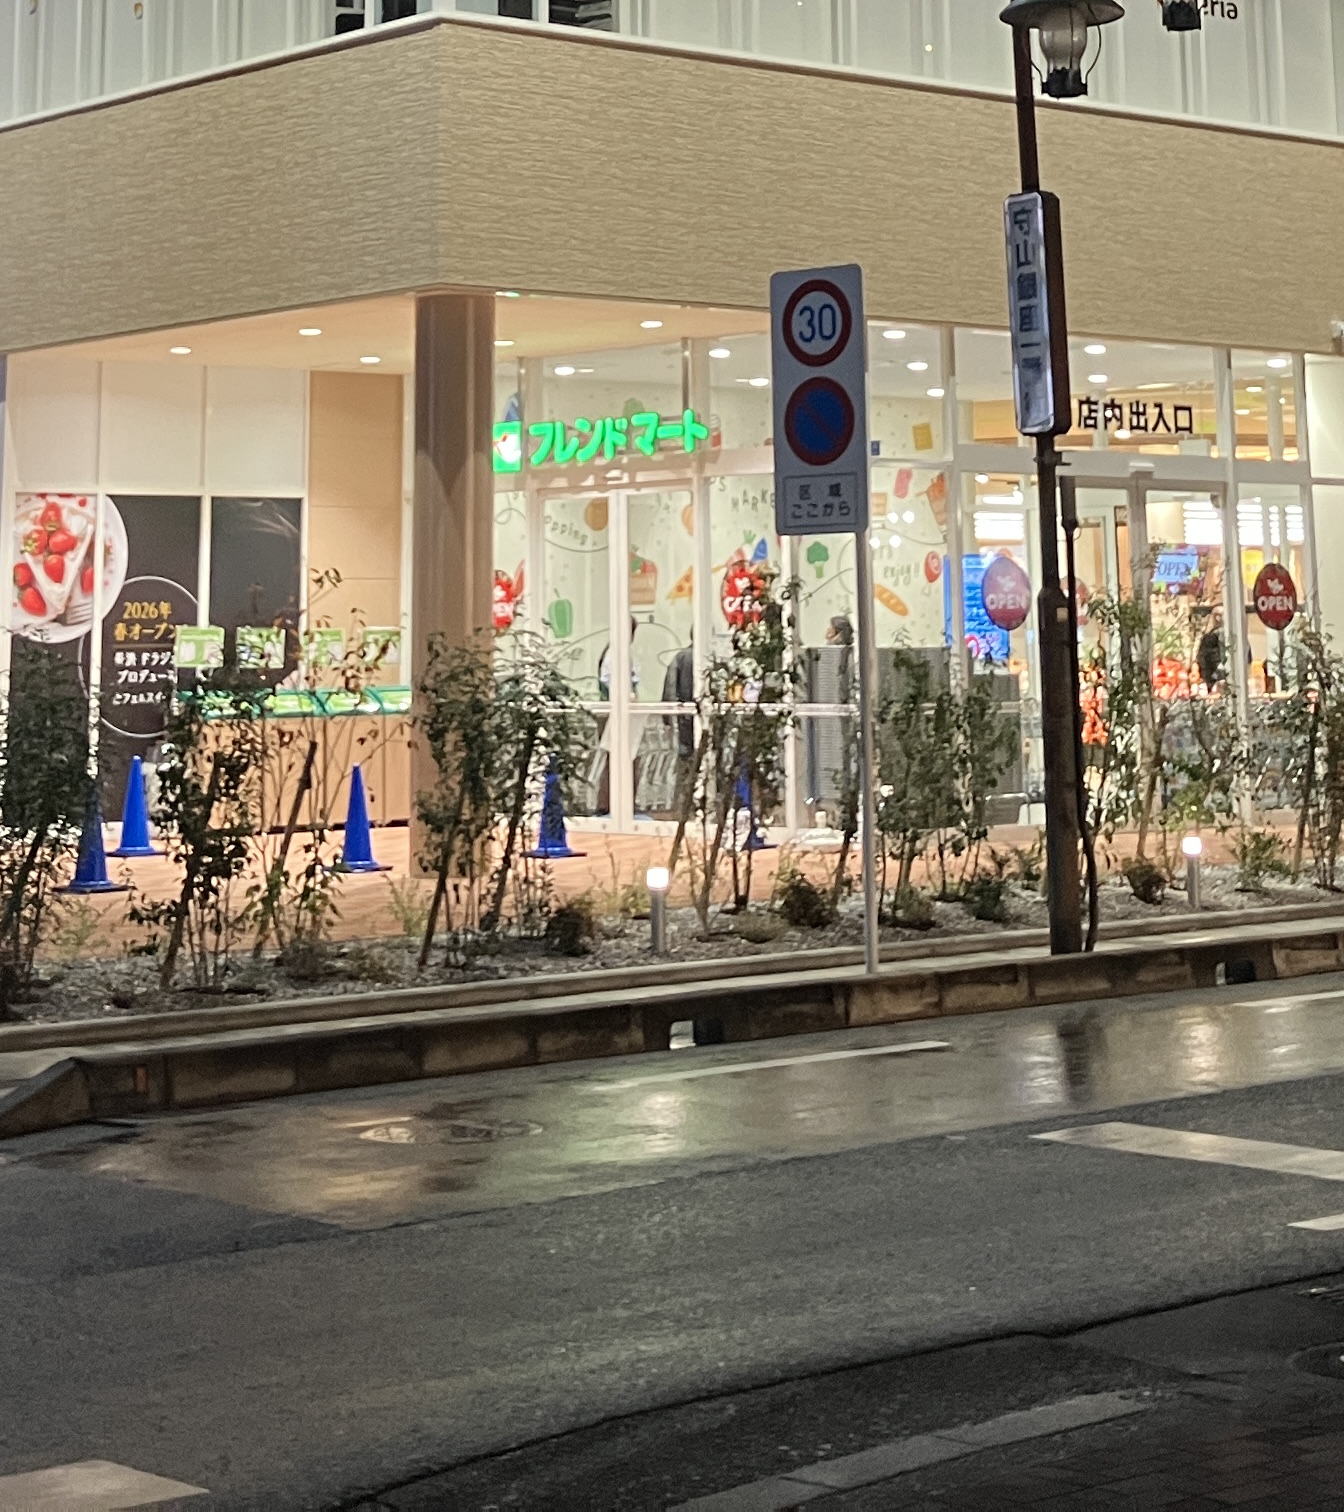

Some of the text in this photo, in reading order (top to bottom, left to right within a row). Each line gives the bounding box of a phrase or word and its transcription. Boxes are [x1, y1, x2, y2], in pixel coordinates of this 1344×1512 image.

[798, 303, 837, 344] 30
[1078, 396, 1193, 434] 店内出入口
[528, 408, 709, 466] フレンドマート
[730, 488, 775, 513] MARKE
[791, 501, 851, 519] ここから
[122, 600, 173, 620] 2026年
[985, 593, 1028, 610] OPEN
[1257, 596, 1293, 612] OPEN
